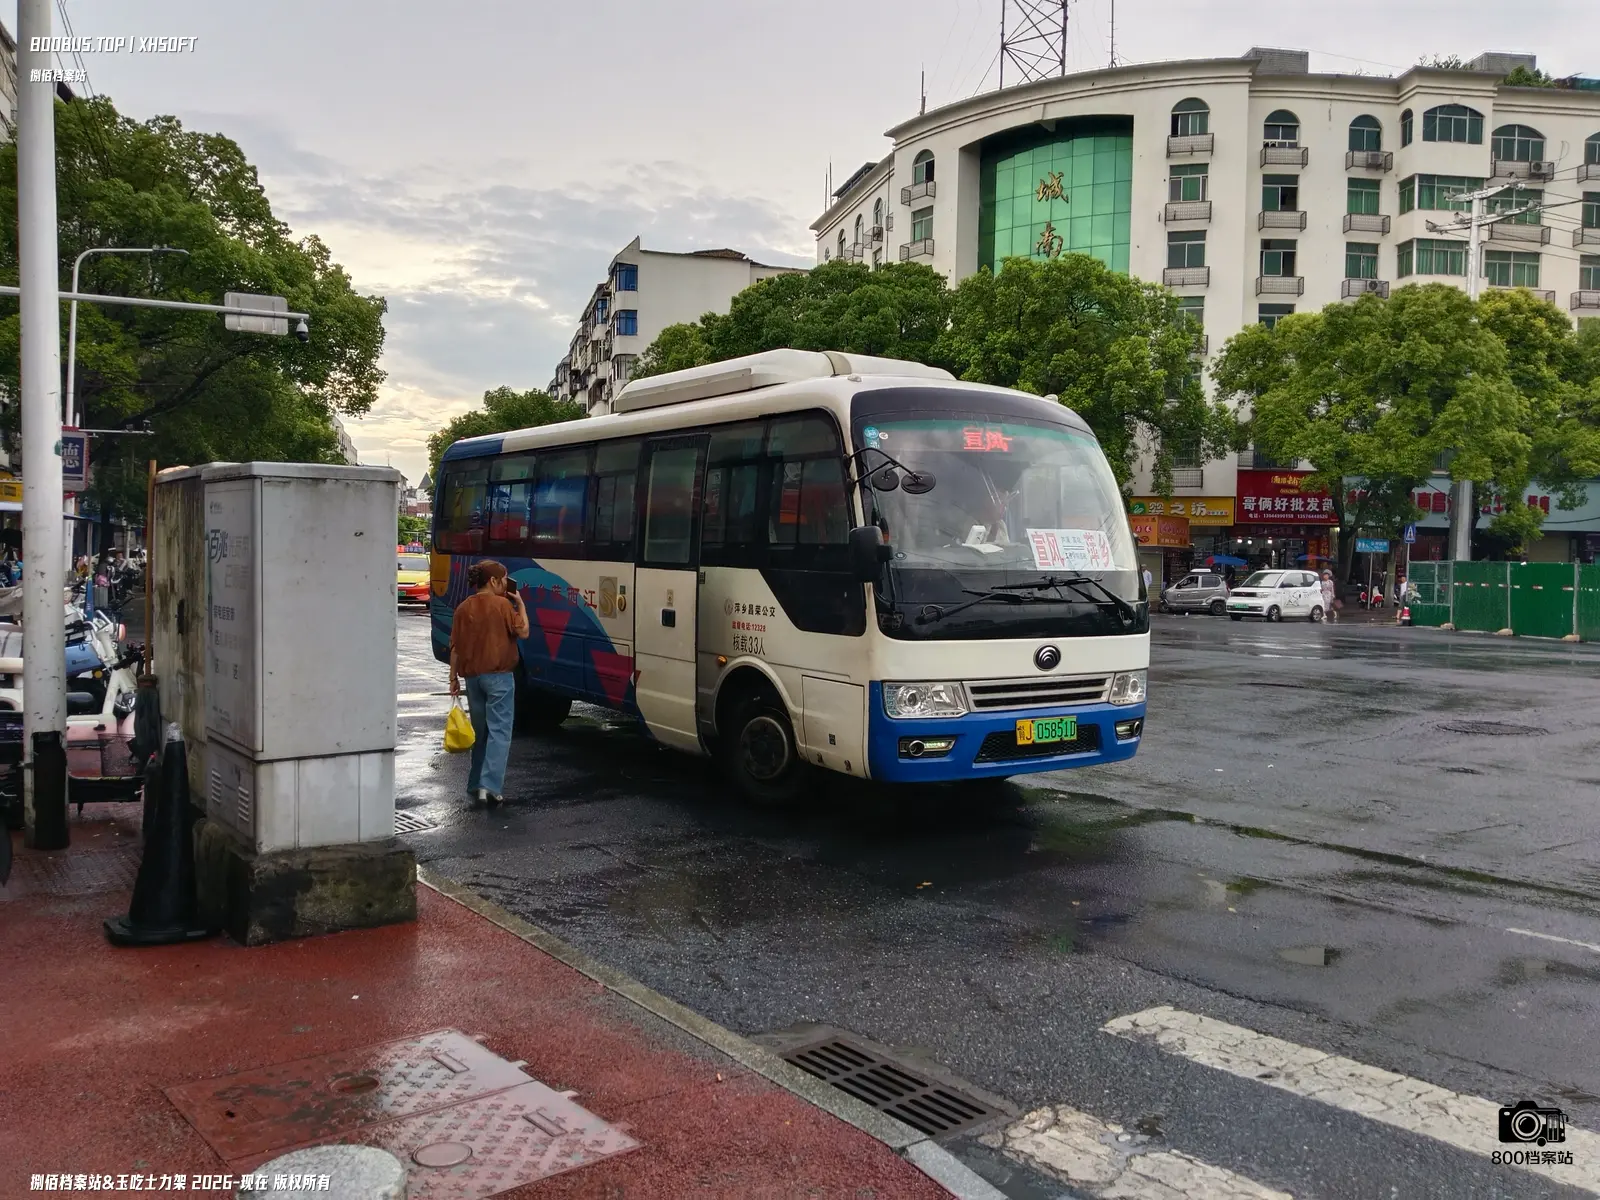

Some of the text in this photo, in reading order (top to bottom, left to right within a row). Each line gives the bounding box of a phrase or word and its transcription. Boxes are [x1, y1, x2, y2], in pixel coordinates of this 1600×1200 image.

[1243, 496, 1335, 512] 哥俩好批发部
[734, 602, 776, 617] 萍乡昌荣公交
[733, 634, 766, 656] 核载33人
